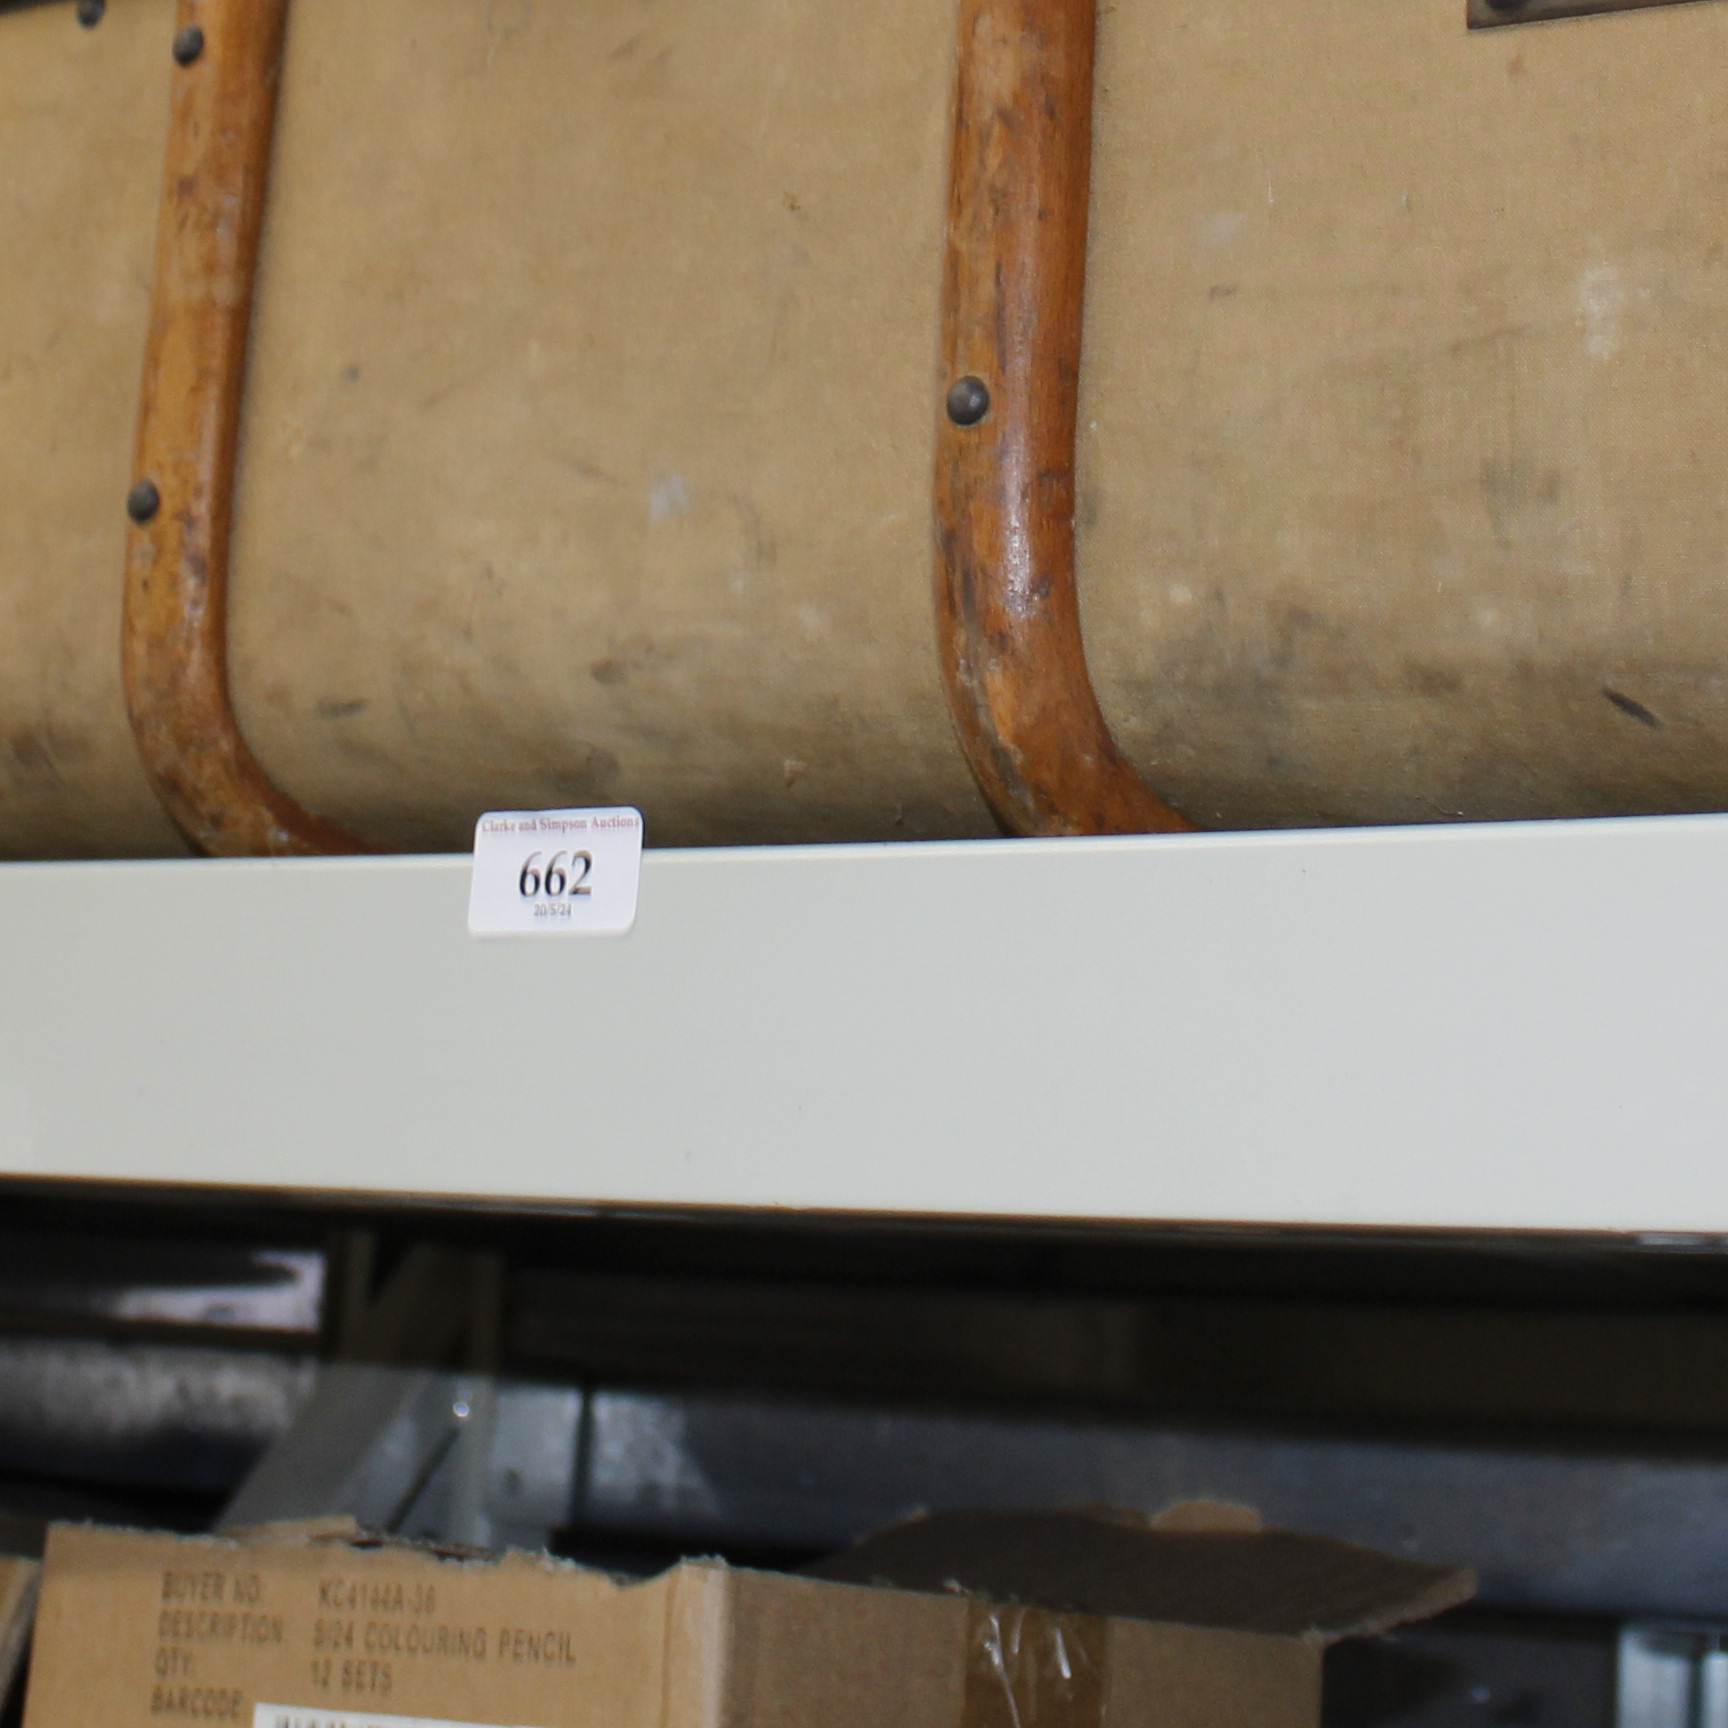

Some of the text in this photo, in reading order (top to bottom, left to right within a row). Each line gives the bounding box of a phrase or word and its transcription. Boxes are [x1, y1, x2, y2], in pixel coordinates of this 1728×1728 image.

[518, 818, 537, 832] and
[539, 817, 587, 834] Simpson
[592, 814, 640, 830] Auctions
[519, 849, 593, 897] 662
[364, 1619, 487, 1659] COLOURING
[498, 1625, 577, 1665] PENCIL
